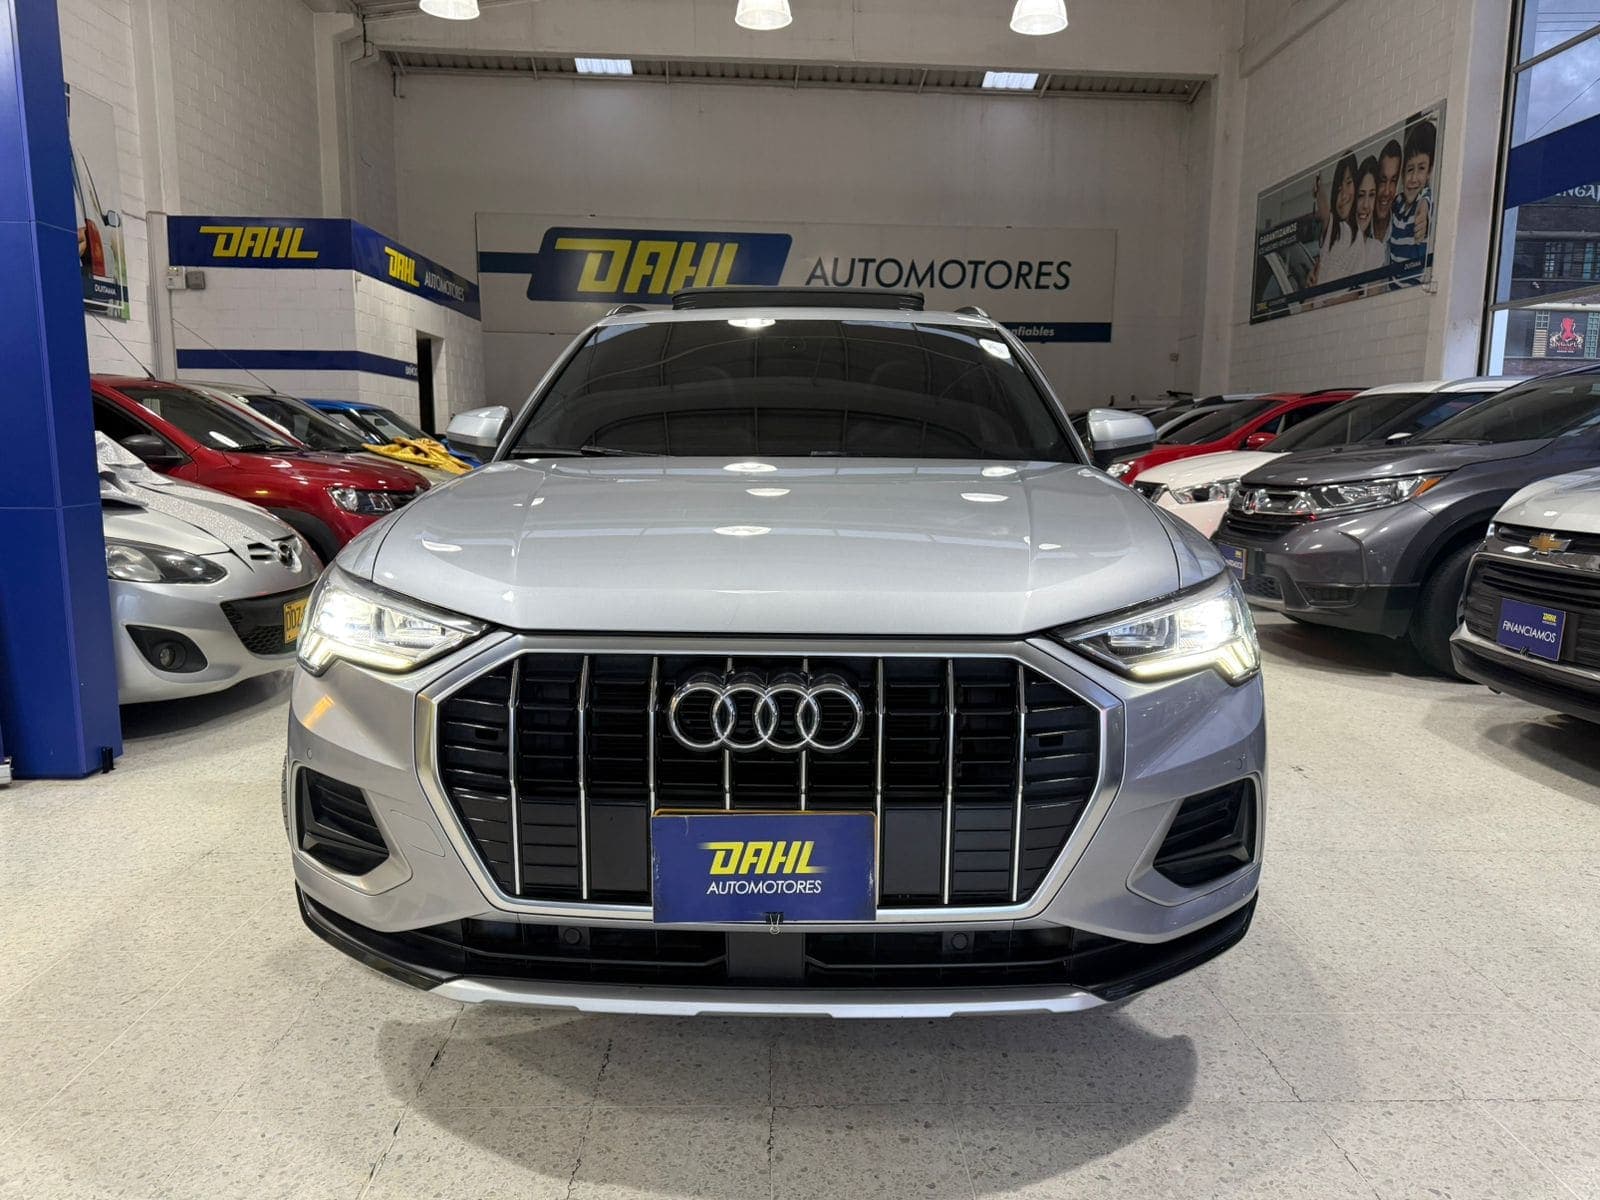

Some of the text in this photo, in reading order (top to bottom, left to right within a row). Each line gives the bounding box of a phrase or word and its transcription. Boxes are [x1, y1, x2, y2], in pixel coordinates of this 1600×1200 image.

[199, 226, 319, 258] DAHL
[384, 246, 465, 302] DAHL AUTOMOTORES
[805, 257, 1072, 290] AUTOMOTORES
[1502, 620, 1557, 643] FINANCIAMOS
[699, 841, 829, 875] DAHL
[706, 880, 822, 895] AUTOMOTORES
